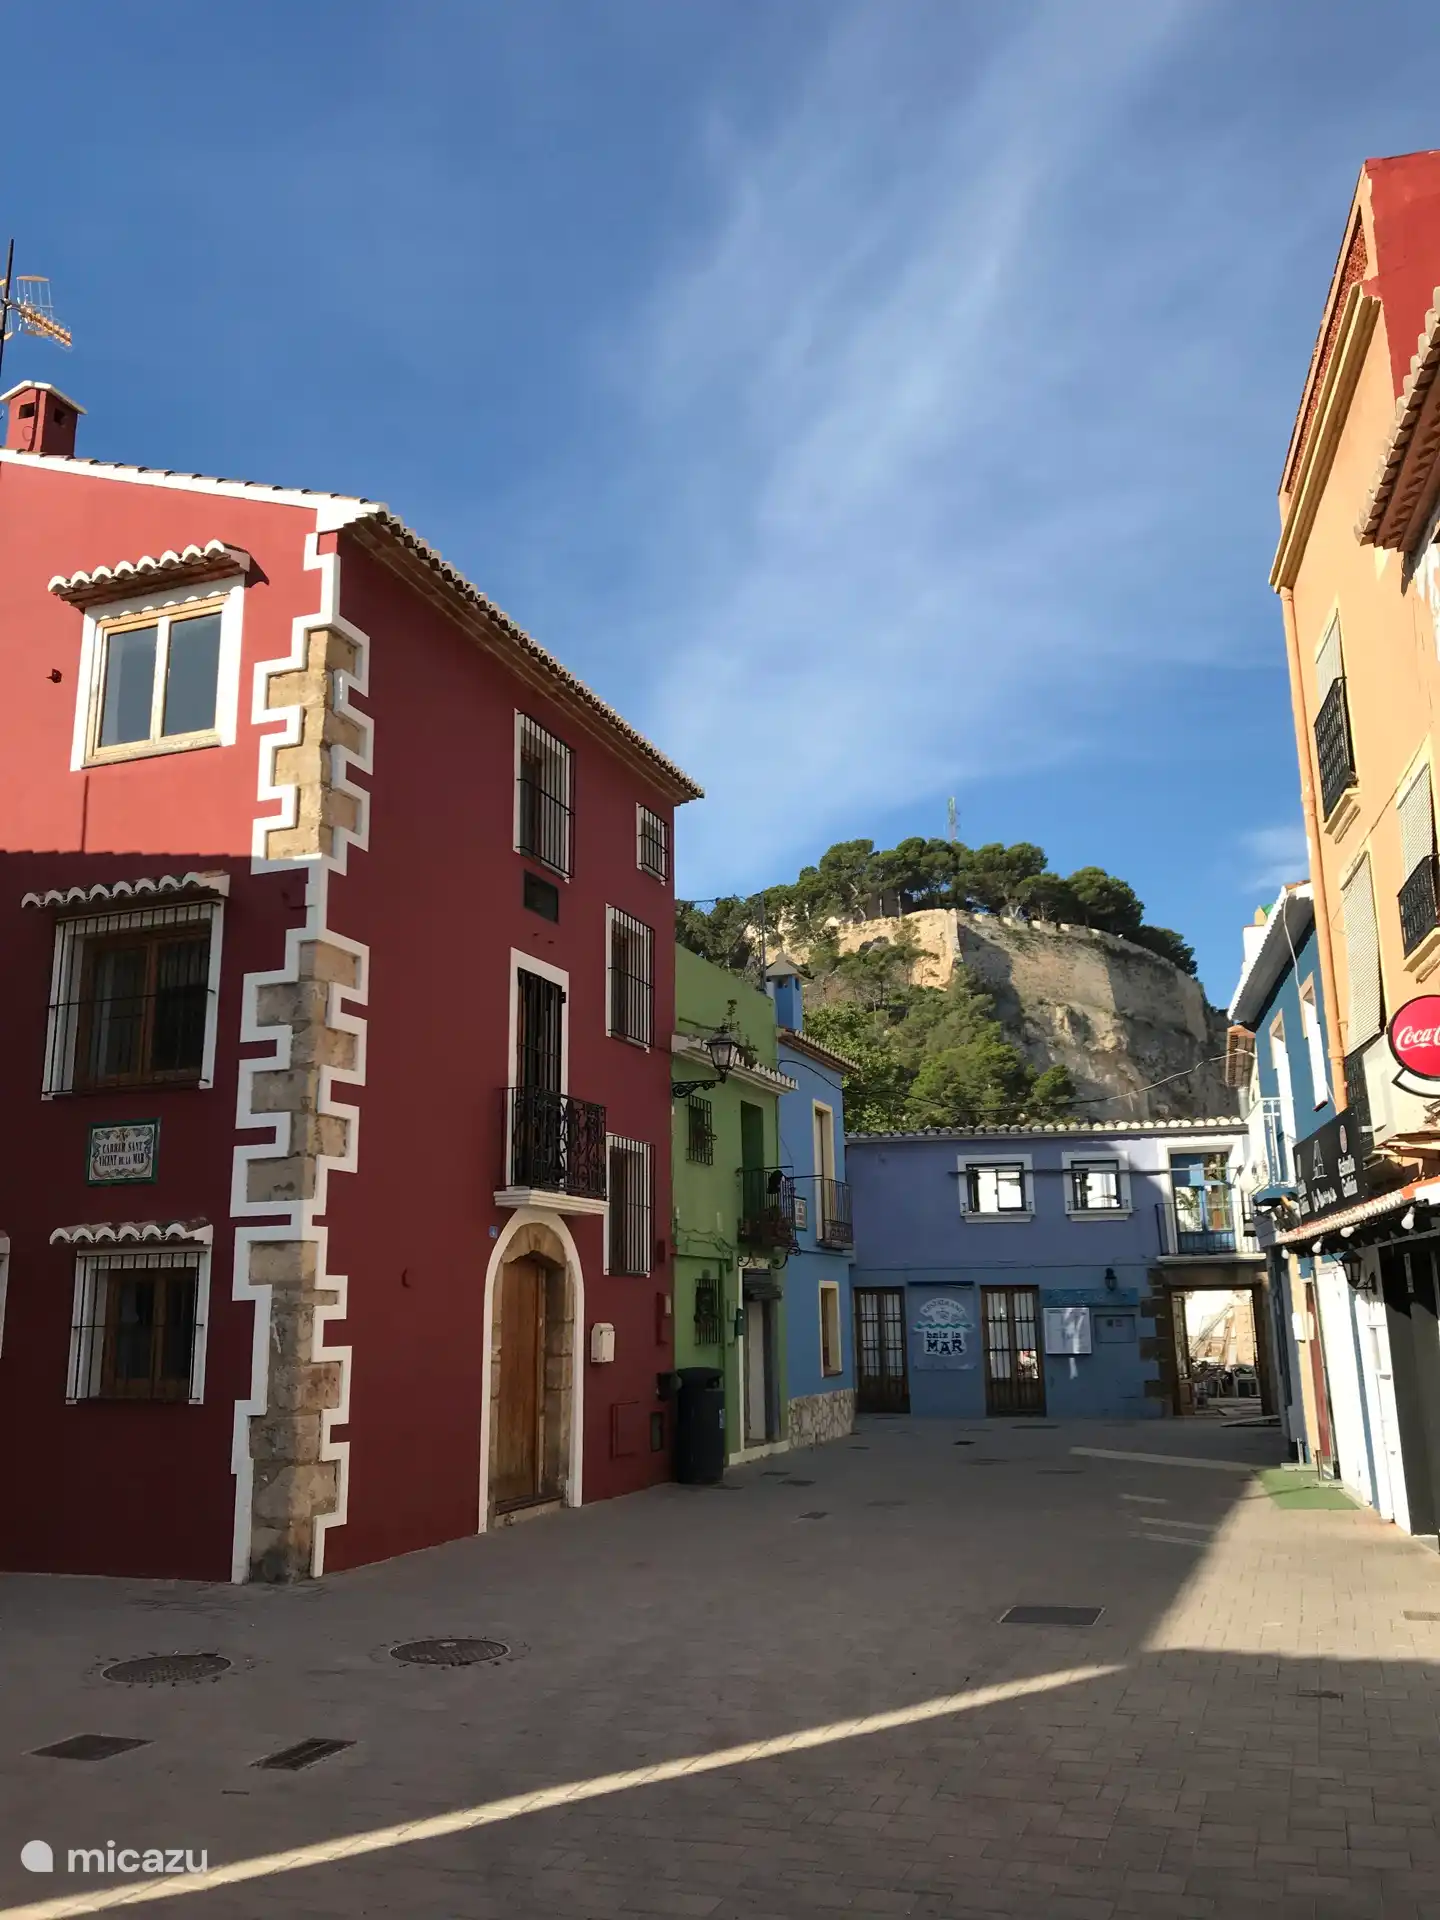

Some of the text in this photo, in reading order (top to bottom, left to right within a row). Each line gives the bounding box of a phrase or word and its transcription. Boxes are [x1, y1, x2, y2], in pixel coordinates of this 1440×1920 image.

[102, 1141, 143, 1154] CARRER SANT
[99, 1154, 117, 1167] VICENT
[132, 1153, 144, 1164] MAR
[926, 1339, 965, 1356] MAR
